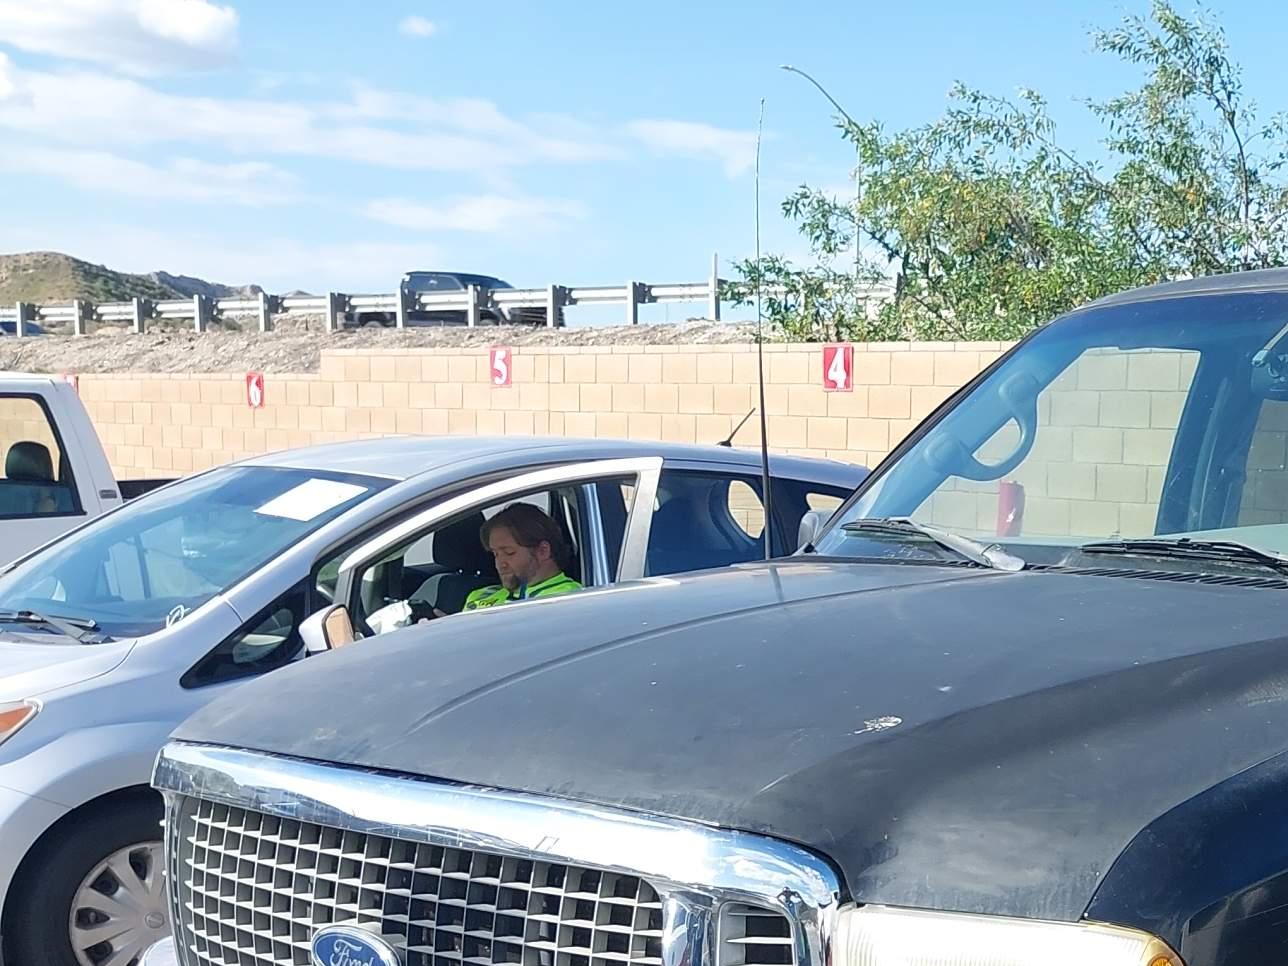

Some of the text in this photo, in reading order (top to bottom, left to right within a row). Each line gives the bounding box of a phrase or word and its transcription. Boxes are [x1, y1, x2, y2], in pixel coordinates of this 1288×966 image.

[493, 350, 508, 385] 5
[828, 347, 847, 389] 4
[249, 376, 261, 407] 6
